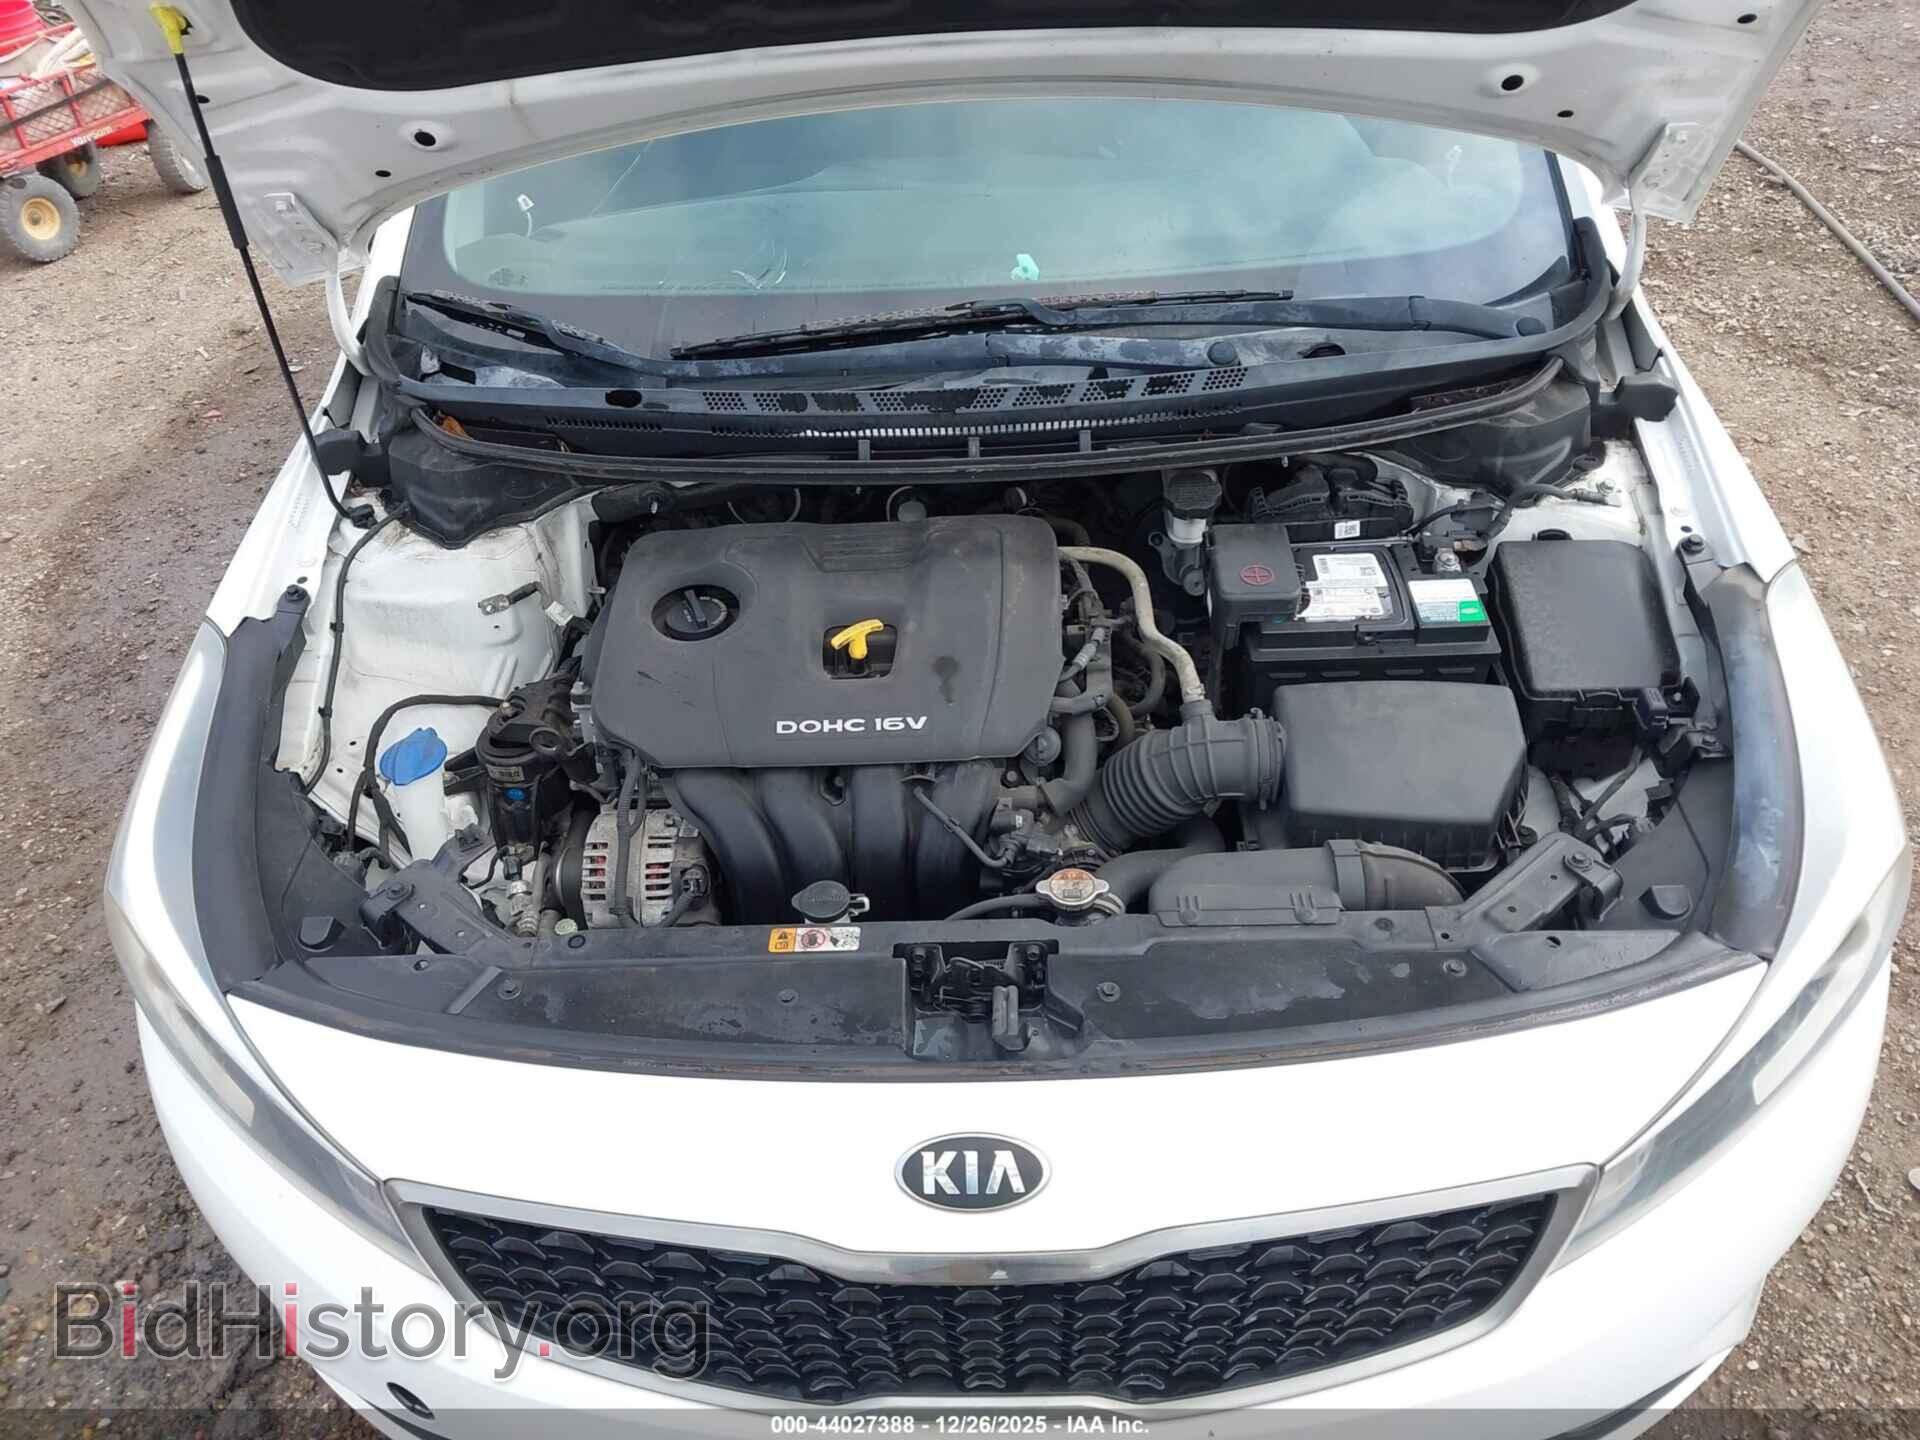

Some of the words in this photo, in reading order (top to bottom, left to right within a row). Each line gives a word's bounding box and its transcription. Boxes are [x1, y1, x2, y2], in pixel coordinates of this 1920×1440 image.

[776, 718, 866, 734] DOHC
[874, 716, 928, 731] 16V
[920, 1150, 1026, 1195] KIA
